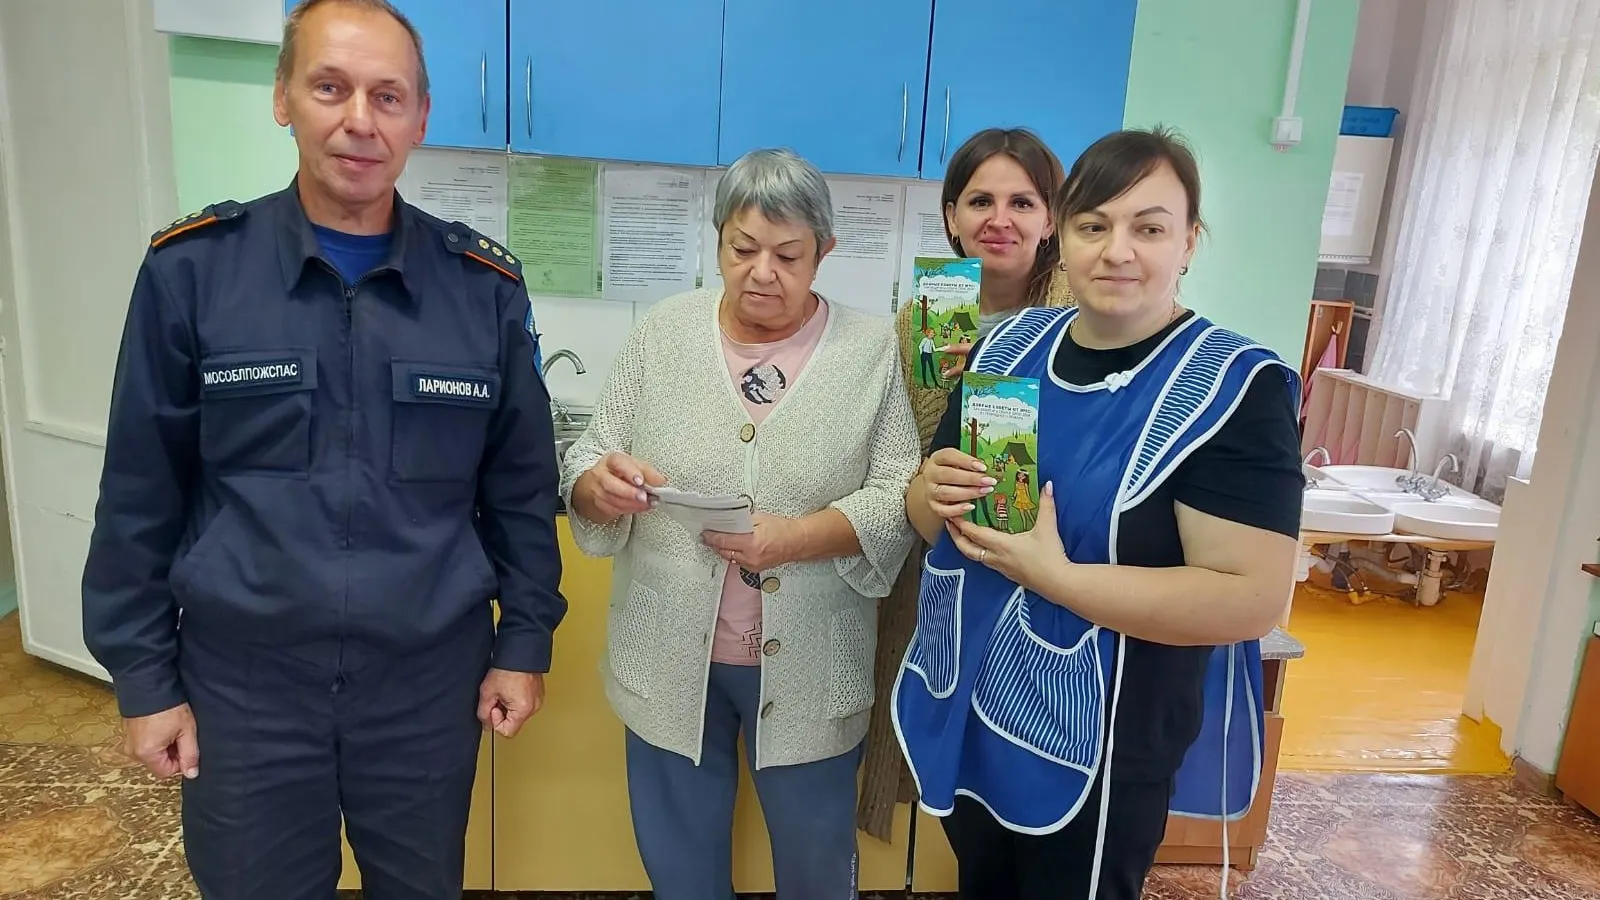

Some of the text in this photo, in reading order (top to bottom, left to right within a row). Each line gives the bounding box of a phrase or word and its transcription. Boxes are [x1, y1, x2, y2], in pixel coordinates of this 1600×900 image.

[203, 363, 298, 385] МОСОБЛПОЖСПАС
[418, 377, 491, 398] ЛАРИОНОВ А.А.
